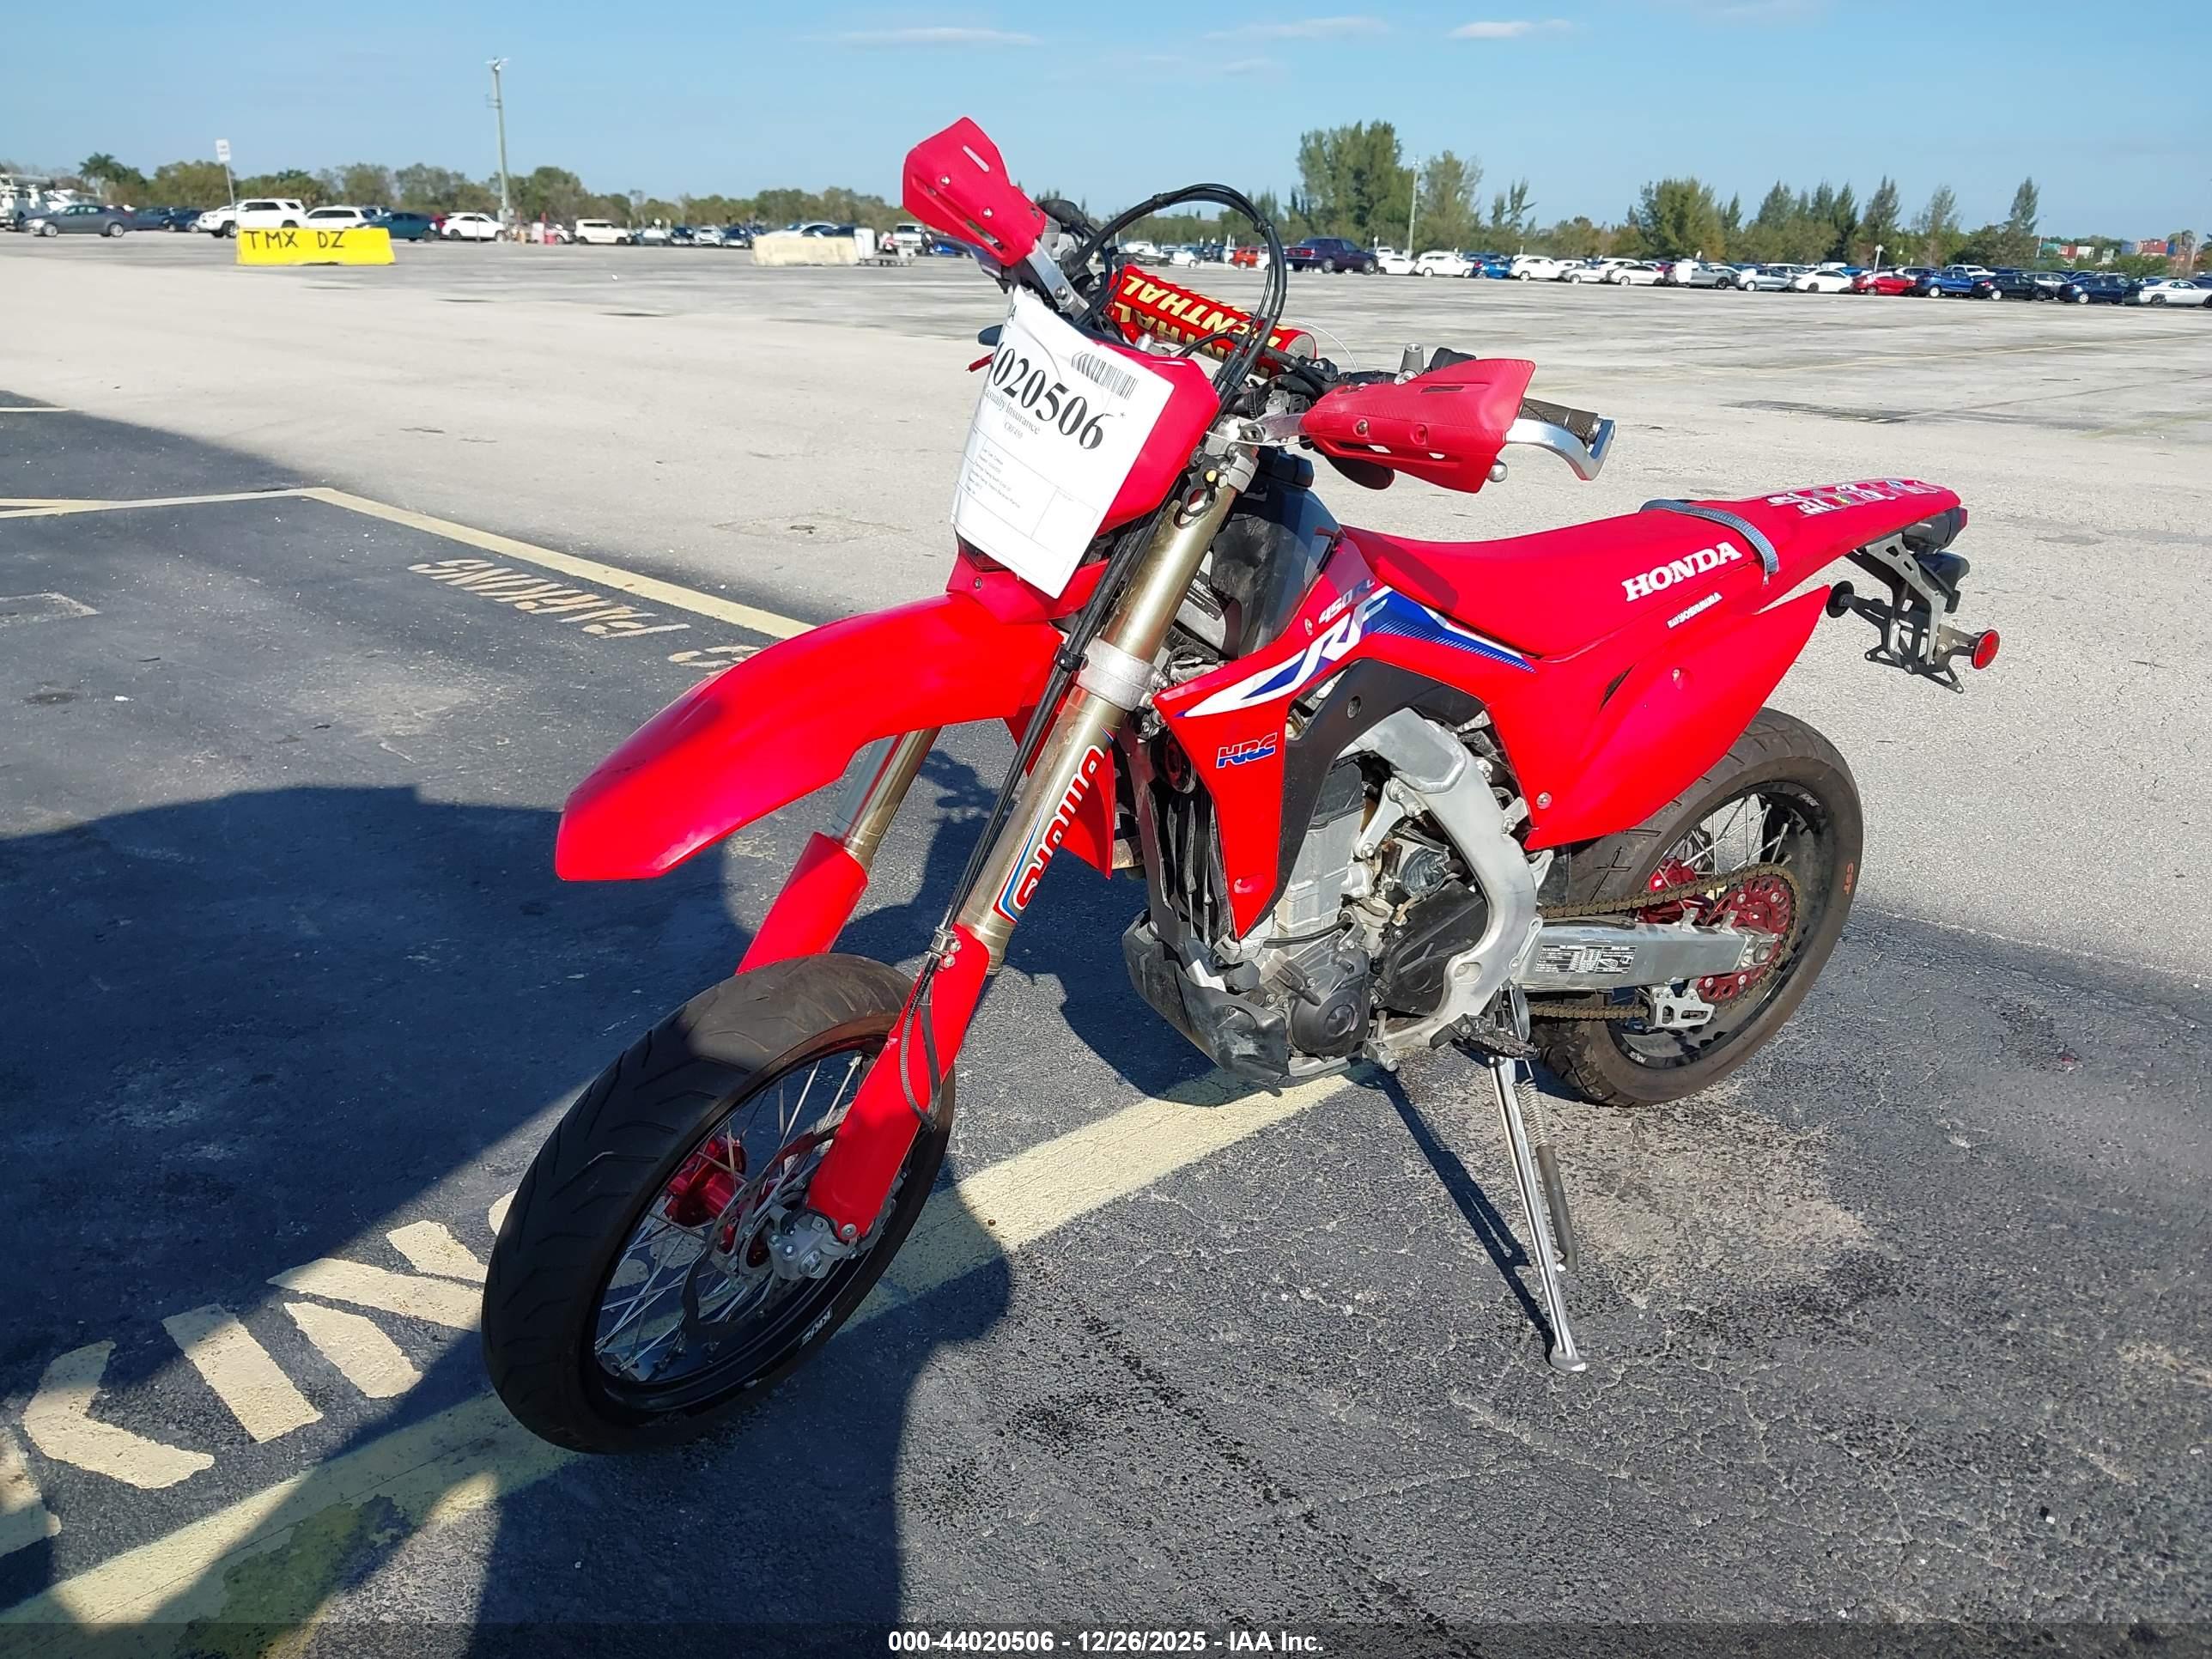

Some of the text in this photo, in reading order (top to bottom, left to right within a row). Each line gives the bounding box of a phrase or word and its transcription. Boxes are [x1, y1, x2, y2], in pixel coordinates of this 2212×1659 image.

[244, 231, 346, 248] TMX DZ
[407, 559, 691, 639] PARKING
[1621, 541, 1742, 602] HONDA
[1184, 586, 1392, 717] CRF
[1216, 732, 1278, 769] HRC
